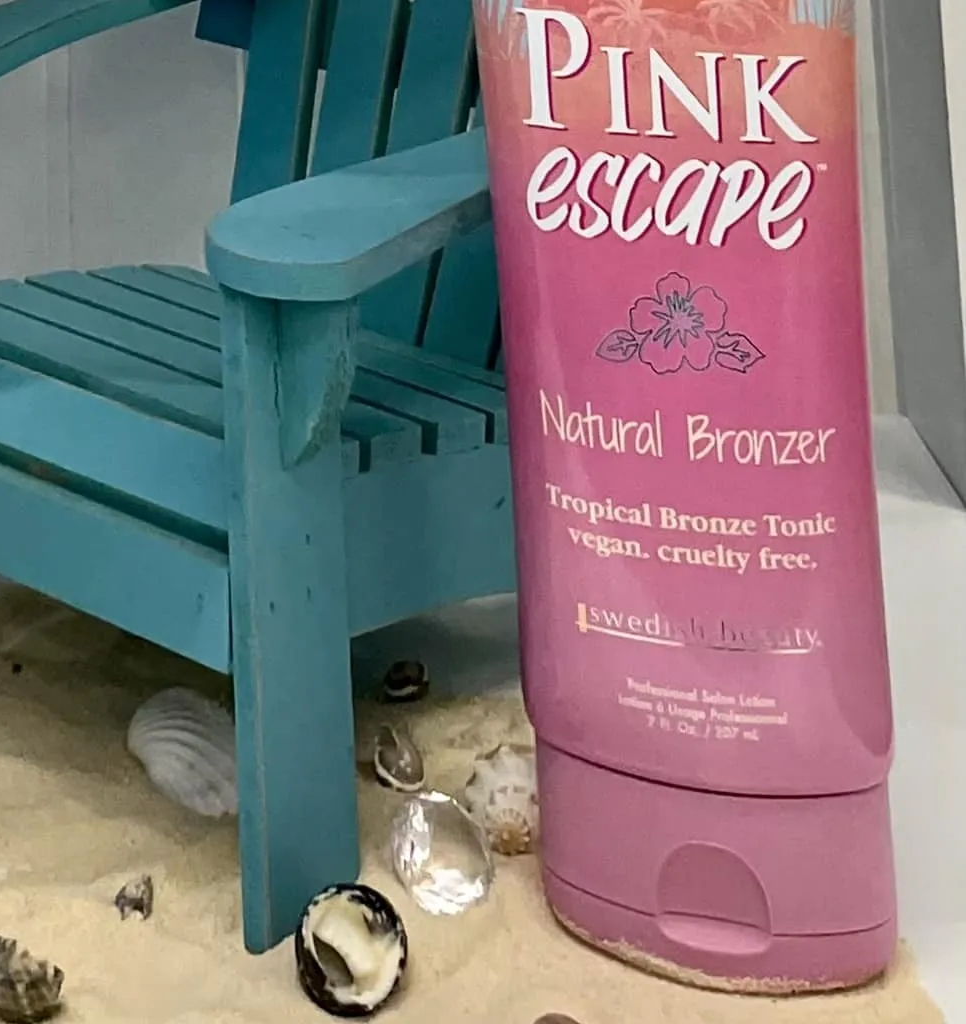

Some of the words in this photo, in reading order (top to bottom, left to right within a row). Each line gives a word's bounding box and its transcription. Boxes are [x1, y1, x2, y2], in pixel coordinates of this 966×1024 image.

[514, 7, 820, 144] PINK
[539, 389, 663, 458] Natural
[687, 414, 836, 465] Bronzer
[545, 482, 652, 527] Tropical
[660, 506, 757, 537] Bronze
[763, 512, 835, 537] Tonic
[567, 526, 651, 560] vegan.
[657, 544, 751, 575] cruelty
[758, 547, 818, 571] free.
[668, 705, 705, 720] Usage
